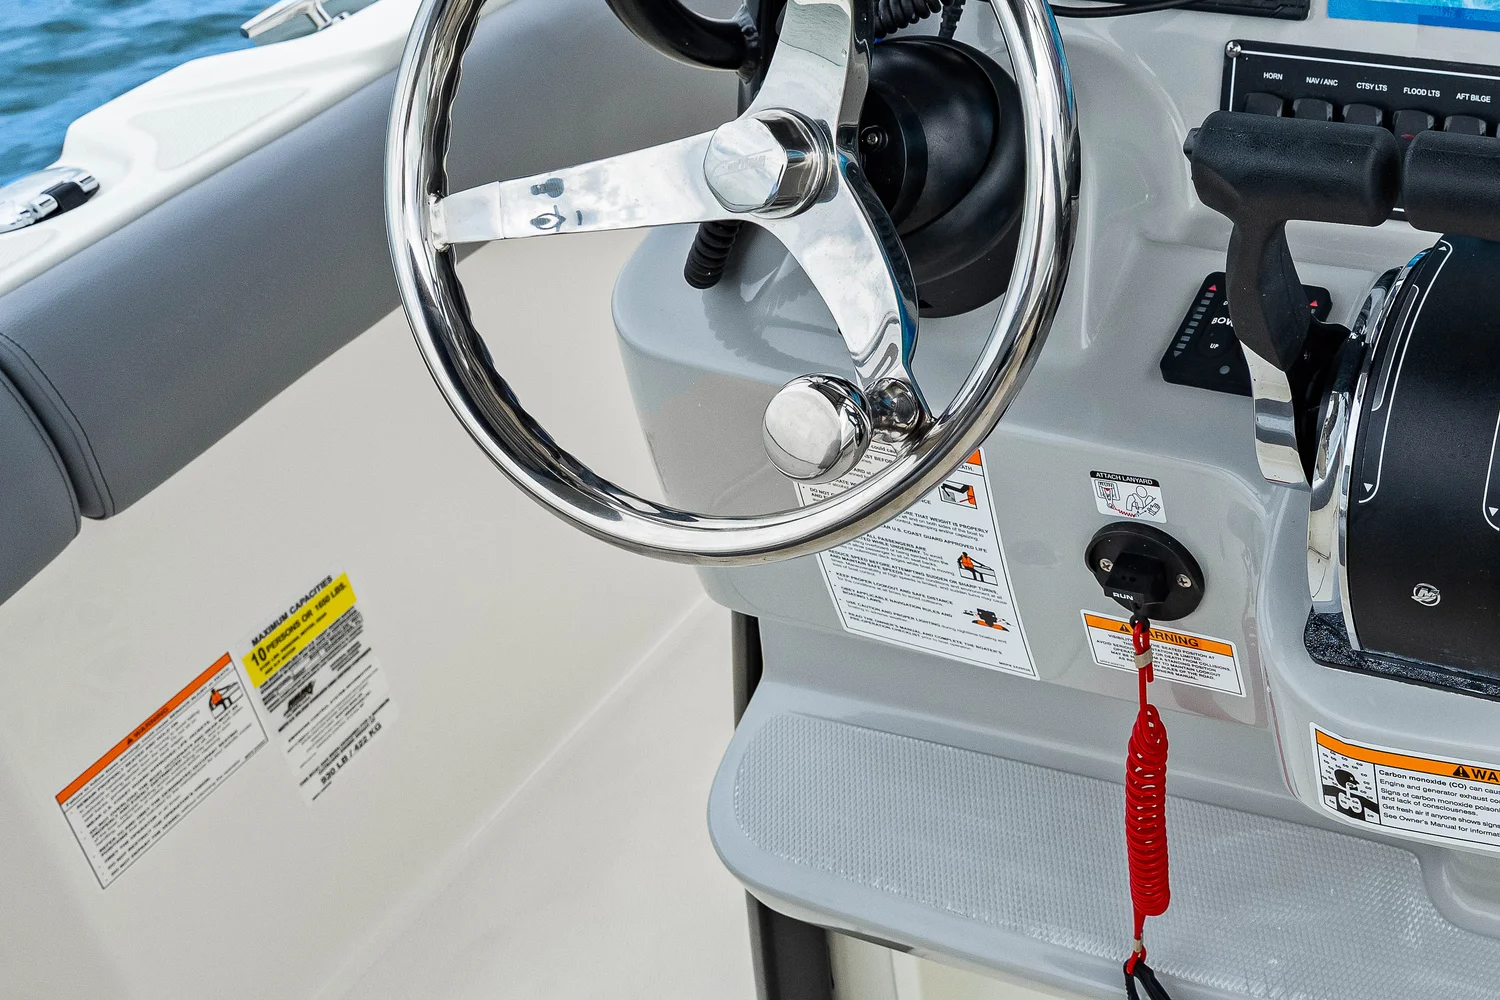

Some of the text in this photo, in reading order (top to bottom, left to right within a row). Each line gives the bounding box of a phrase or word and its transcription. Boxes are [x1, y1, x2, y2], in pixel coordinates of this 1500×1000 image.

[1263, 72, 1283, 80] HORN
[1305, 76, 1320, 85] NAV
[1323, 78, 1339, 87] ANC
[1356, 82, 1388, 92] CTSY LTS
[1404, 87, 1440, 97] FLOOD LTS
[1456, 92, 1491, 103] AFT BILGE
[1095, 472, 1153, 485] ATTACH LANYARD
[1112, 592, 1134, 600] RUN
[251, 575, 333, 646] MAXIMUM CAPACITIES
[251, 648, 267, 666] 10
[266, 620, 301, 653] PERSONS
[301, 609, 313, 622] OR
[1149, 630, 1199, 648] ARNING
[1379, 769, 1407, 780] Carbon
[1409, 775, 1447, 786] monoxide
[1449, 781, 1467, 790] (CO)
